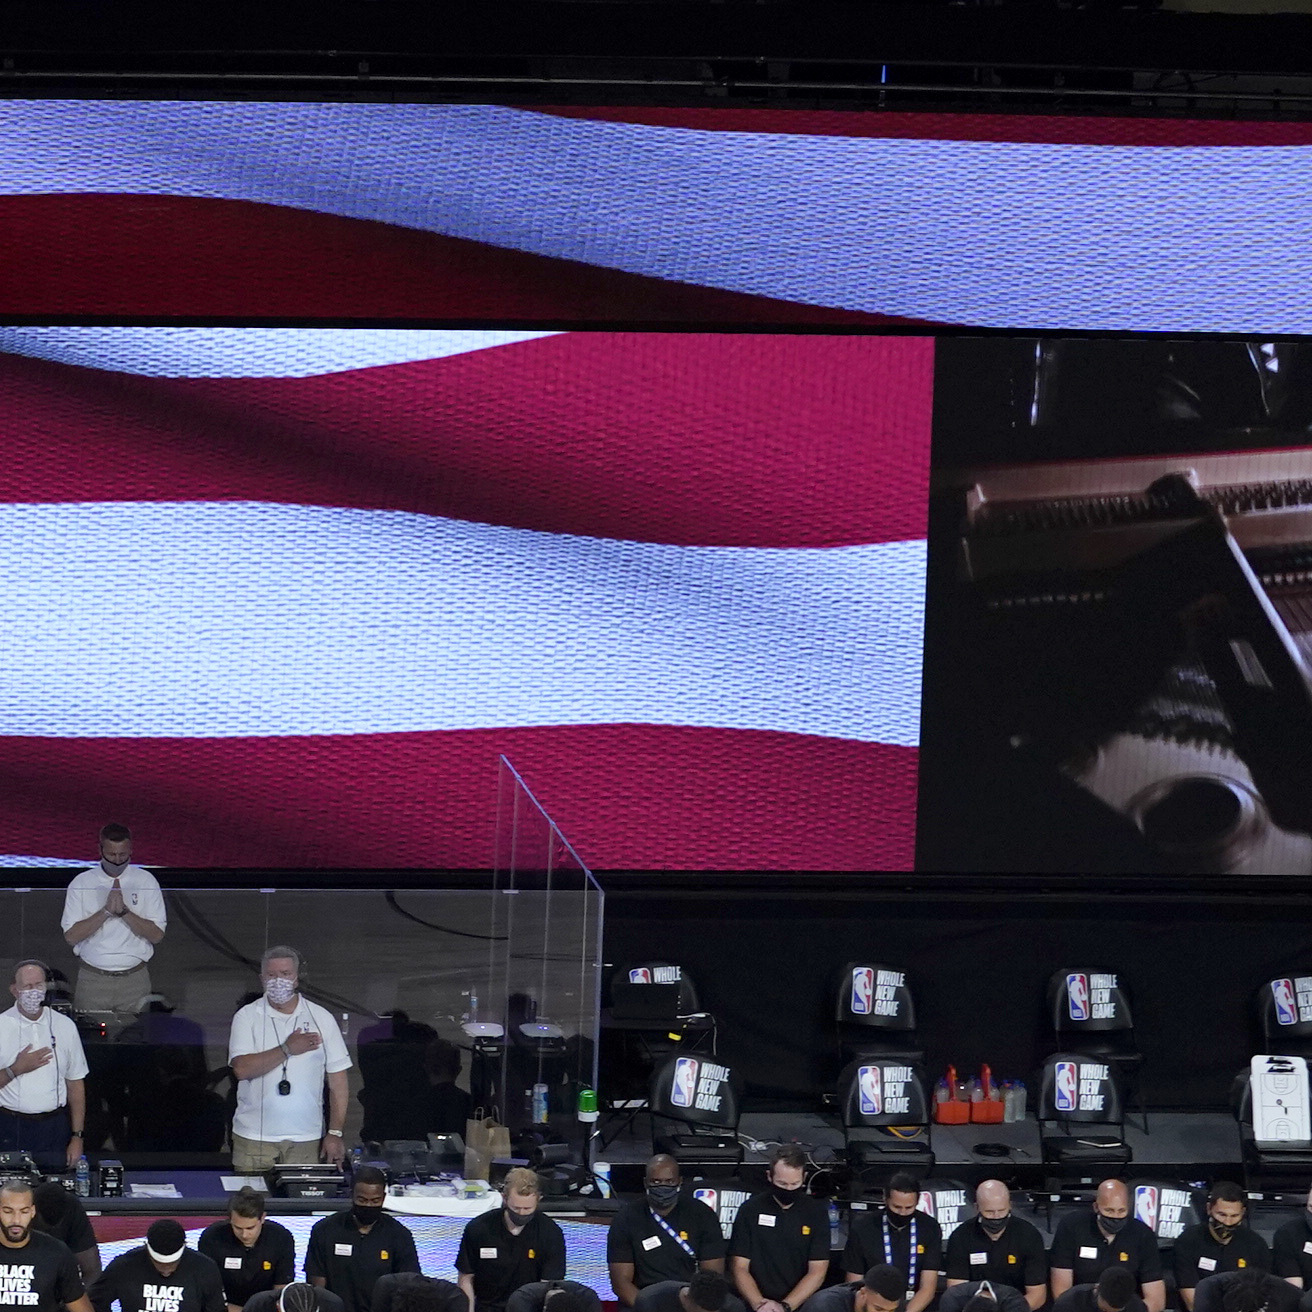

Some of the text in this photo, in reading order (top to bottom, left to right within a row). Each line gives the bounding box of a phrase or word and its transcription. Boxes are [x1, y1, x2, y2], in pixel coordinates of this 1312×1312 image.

[876, 969, 905, 987] WHOLE
[1090, 974, 1117, 989] WHOLE
[875, 985, 897, 1001] NEW
[1090, 988, 1111, 1004] NEW
[874, 1000, 899, 1017] GAME
[1092, 1003, 1116, 1019] GAME
[700, 1062, 731, 1082] WHOLE
[883, 1067, 913, 1082] WHOLE
[1079, 1064, 1109, 1080] WHOLE
[697, 1078, 720, 1096] NEW
[884, 1082, 905, 1098] NEW
[1079, 1079, 1101, 1095] NEW
[695, 1093, 722, 1112] GAME
[884, 1097, 910, 1113] GAME
[1079, 1094, 1104, 1111] GAME
[935, 1190, 966, 1208] WHOLE
[1161, 1188, 1192, 1207] WHOLE
[936, 1206, 959, 1223] NEW
[1159, 1205, 1182, 1222] NEW
[1158, 1220, 1185, 1239] GAME
[143, 1284, 184, 1301] BLACK
[146, 1297, 179, 1312] LIVES
